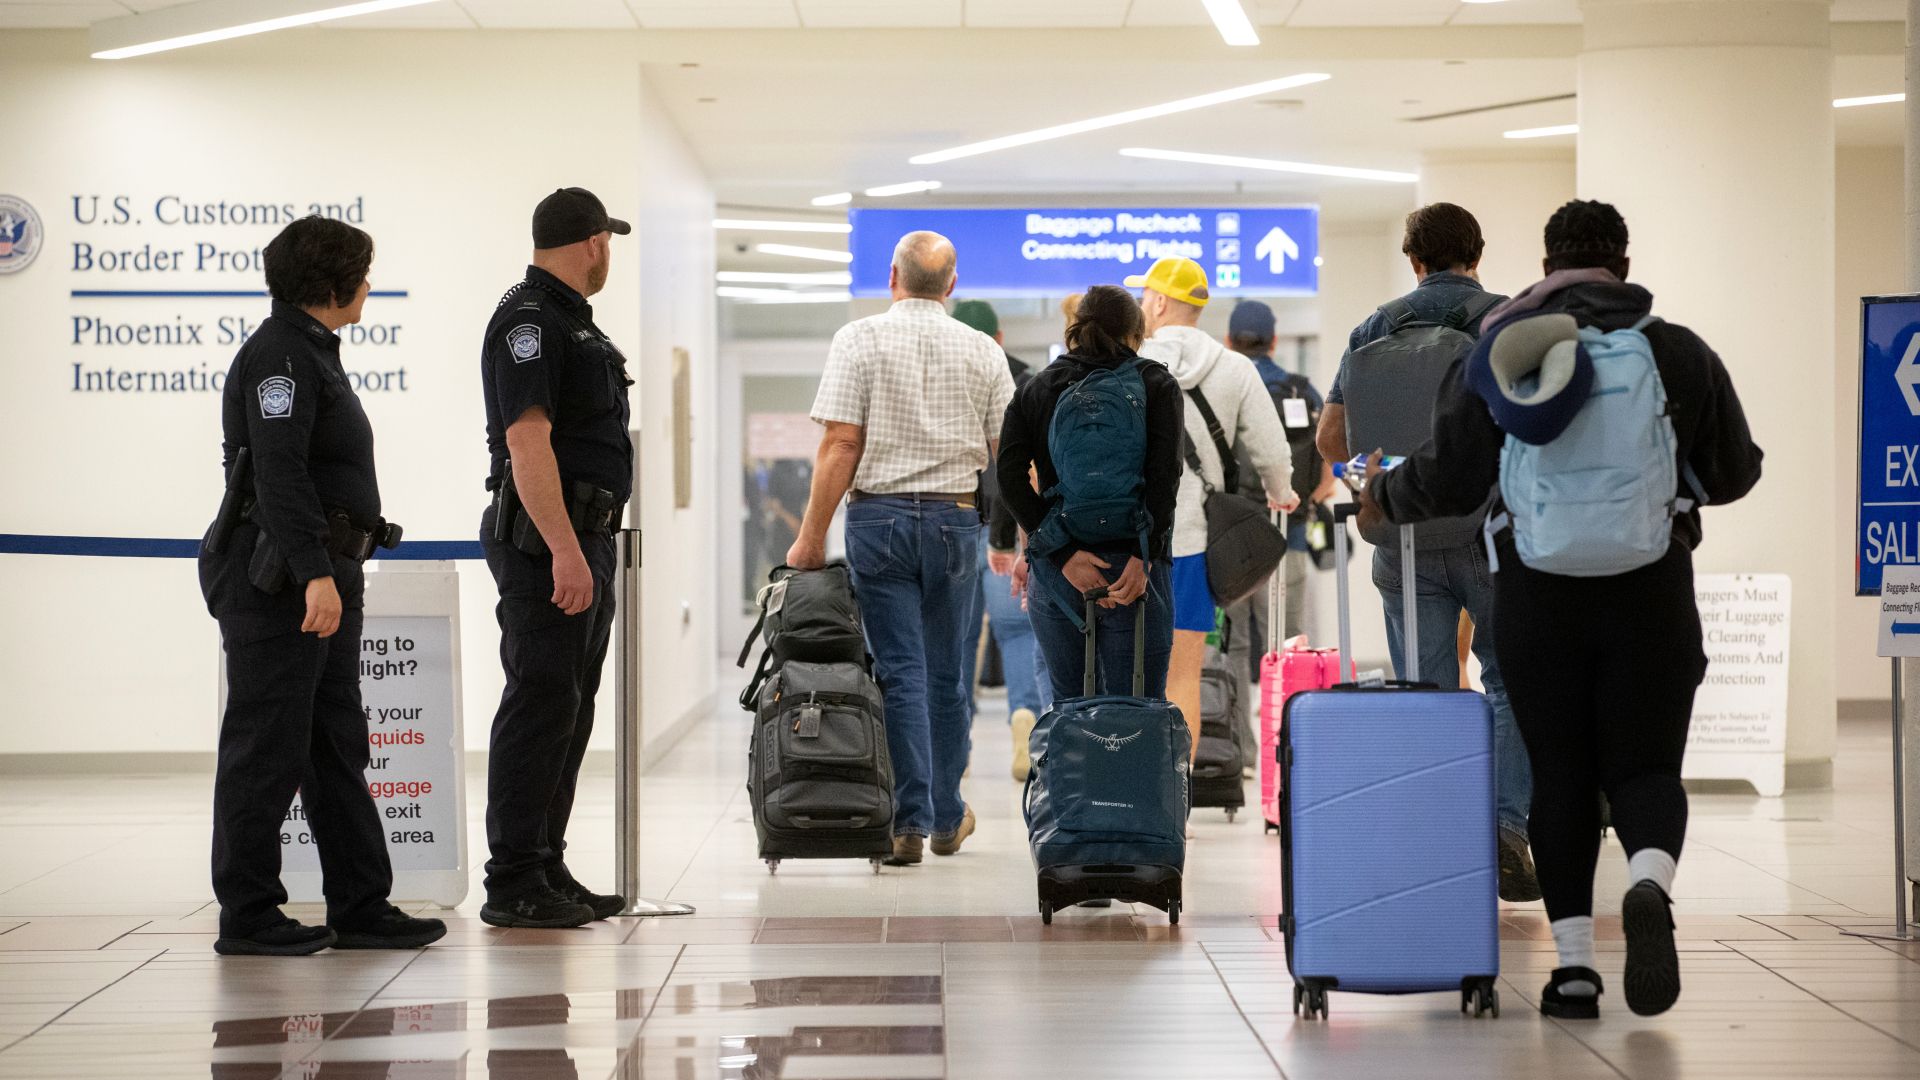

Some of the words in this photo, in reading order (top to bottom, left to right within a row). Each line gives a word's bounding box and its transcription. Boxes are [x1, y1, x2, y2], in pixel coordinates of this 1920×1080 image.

[72, 196, 141, 224] U.S.
[155, 196, 294, 225] Customs
[308, 196, 364, 224] and
[72, 243, 183, 272] Border
[194, 243, 264, 272] Prot
[72, 315, 203, 345] Phoenix
[217, 316, 255, 345] Sk
[337, 324, 402, 346] rbor
[72, 362, 227, 392] Internatio
[1696, 589, 1739, 605] engers
[1744, 588, 1778, 601] Must
[1886, 582, 1909, 595] Baggage
[1883, 602, 1913, 615] Connecting
[1700, 610, 1720, 622] eir
[1725, 609, 1784, 626] Luggage
[395, 636, 415, 651] to
[1707, 630, 1765, 647] Clearing
[1754, 651, 1783, 664] And
[360, 660, 418, 680] light?
[1706, 672, 1765, 685] rotection
[378, 708, 423, 724] your
[369, 729, 425, 749] quids
[369, 781, 432, 798] ggage
[385, 803, 422, 818] exit
[391, 830, 434, 843] area
